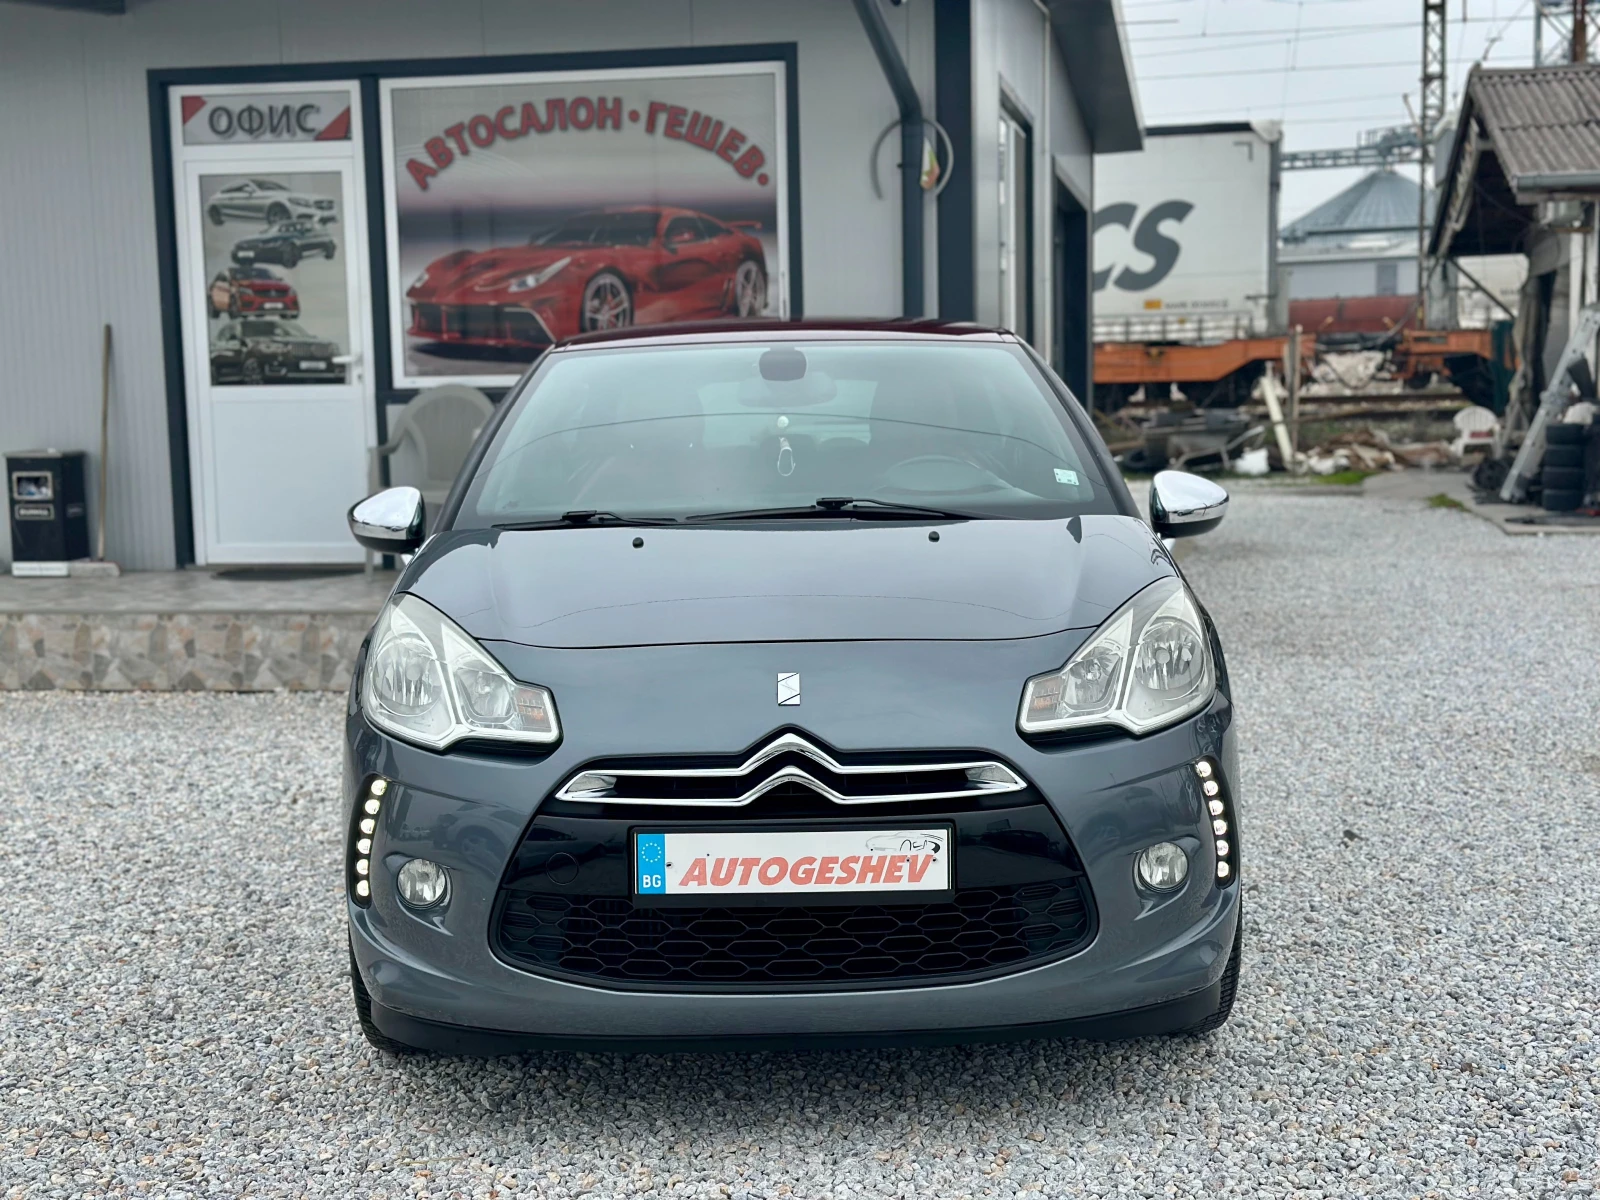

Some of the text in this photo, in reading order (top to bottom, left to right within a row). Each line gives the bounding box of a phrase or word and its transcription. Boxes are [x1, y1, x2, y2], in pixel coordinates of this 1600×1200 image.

[208, 104, 320, 138] ОФИС
[406, 96, 623, 191] АВТОСАЛОН
[642, 874, 662, 888] BG
[678, 854, 935, 887] AUTOGESHEV
